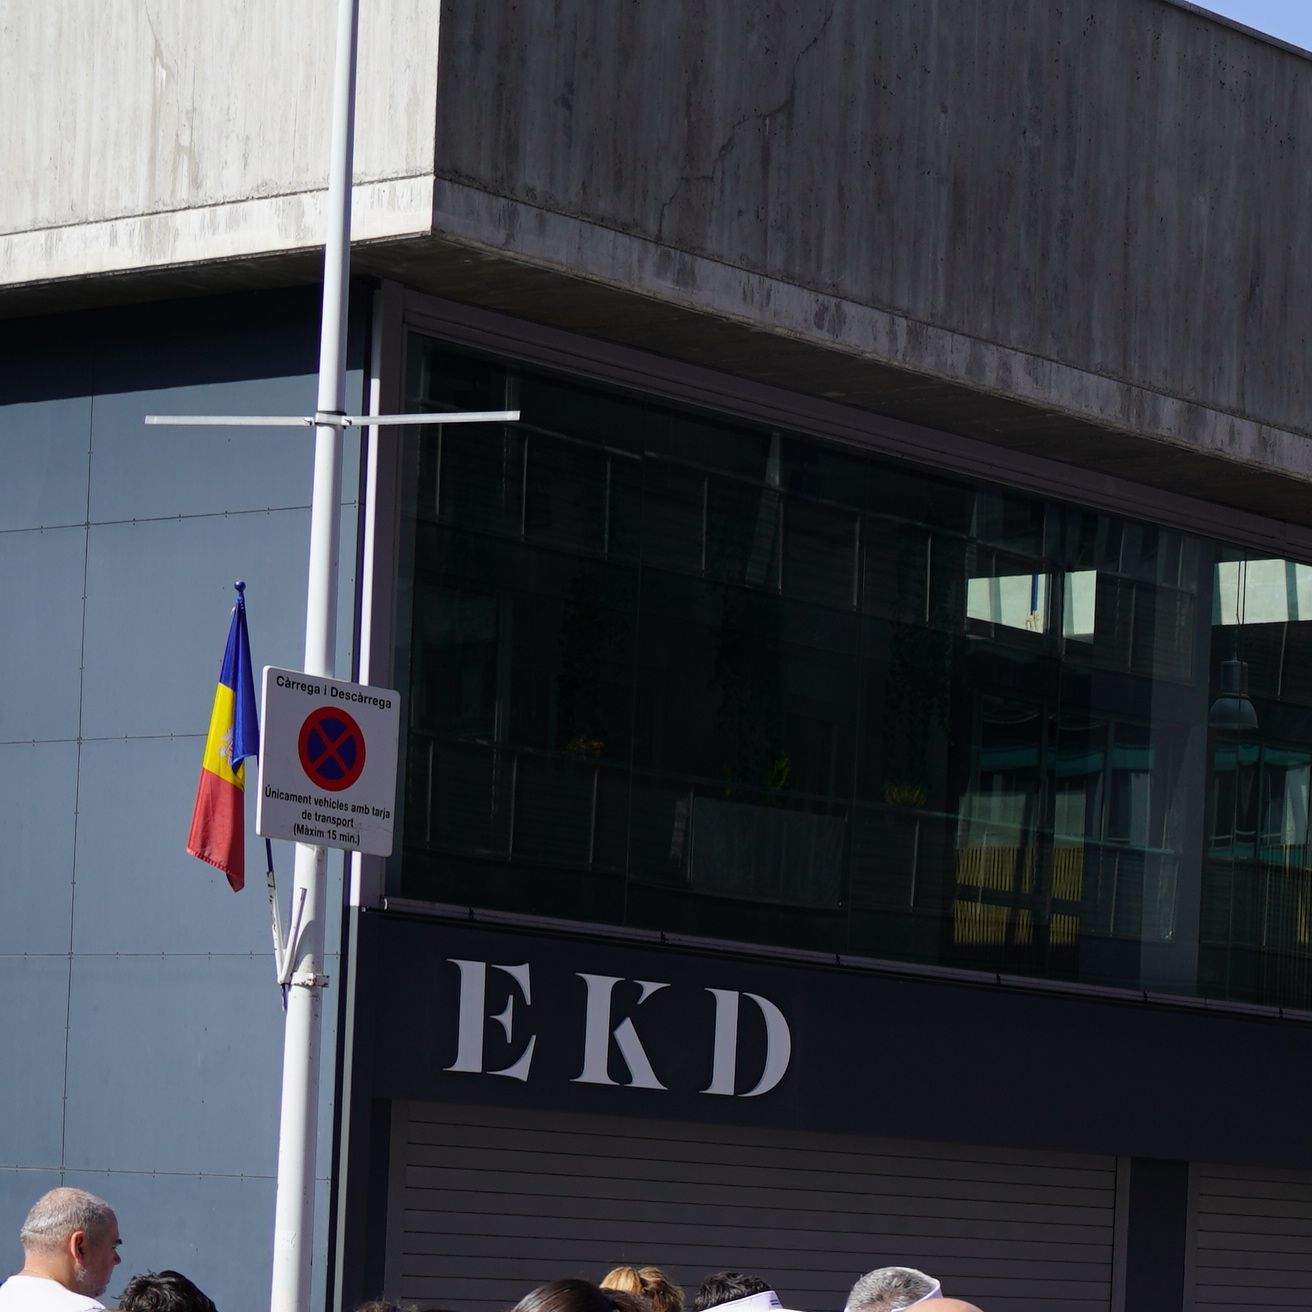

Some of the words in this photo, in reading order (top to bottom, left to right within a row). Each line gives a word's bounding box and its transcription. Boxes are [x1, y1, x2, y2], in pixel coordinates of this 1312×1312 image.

[276, 675, 321, 696] Càrrega
[330, 686, 392, 710] Descàrrega
[264, 784, 312, 805] Únicament
[313, 797, 349, 812] vehicles
[350, 802, 370, 815] amb
[371, 805, 391, 820] tarja
[301, 809, 313, 821] de
[314, 811, 354, 828] transport
[293, 824, 325, 839] (Màxim
[327, 829, 337, 841] 15
[339, 831, 361, 846] min.)
